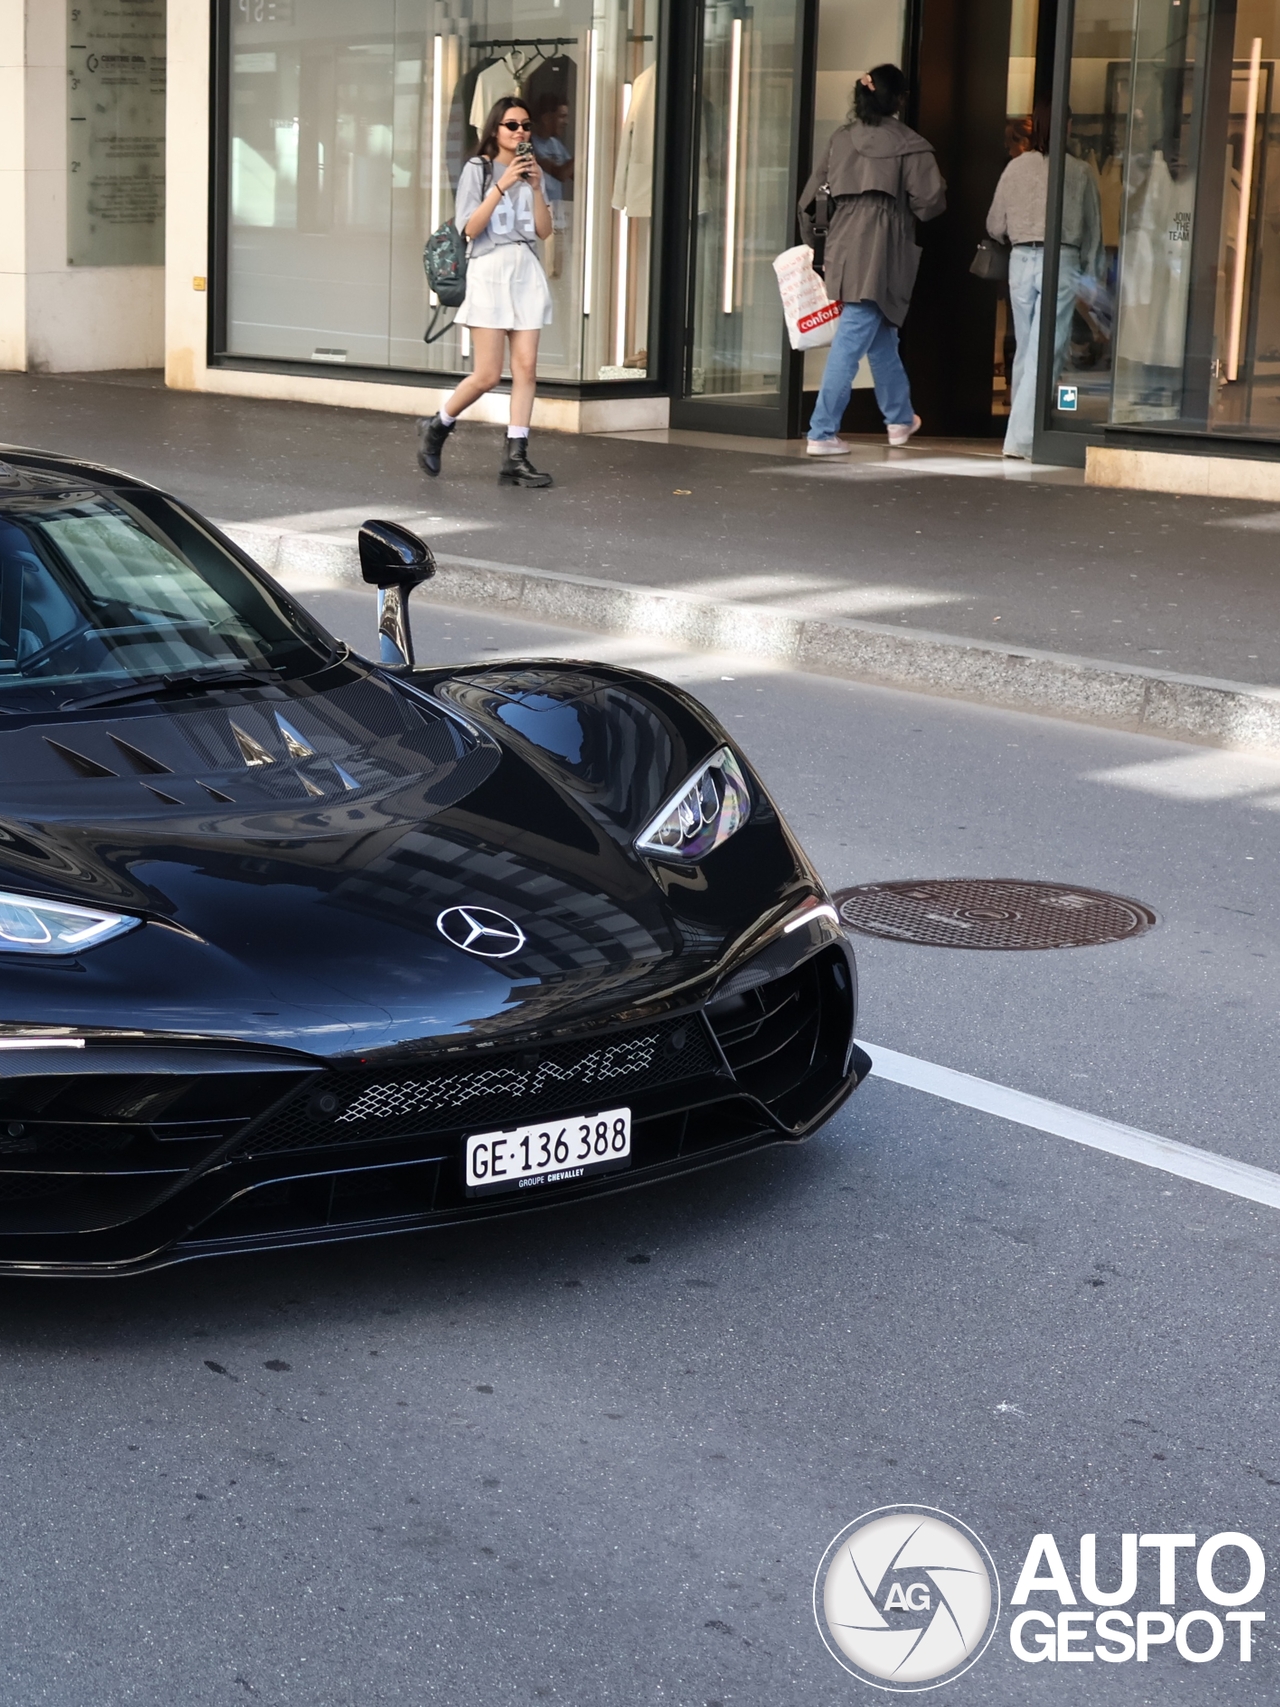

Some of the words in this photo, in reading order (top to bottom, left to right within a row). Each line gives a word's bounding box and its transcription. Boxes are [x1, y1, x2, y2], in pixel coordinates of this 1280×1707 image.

[1173, 212, 1191, 222] JOIN
[1177, 221, 1191, 232] THE
[1169, 231, 1190, 241] TEAM
[577, 1117, 626, 1160] 388
[518, 1175, 545, 1188] GROUPE
[547, 1168, 585, 1182] CHEVALLEY
